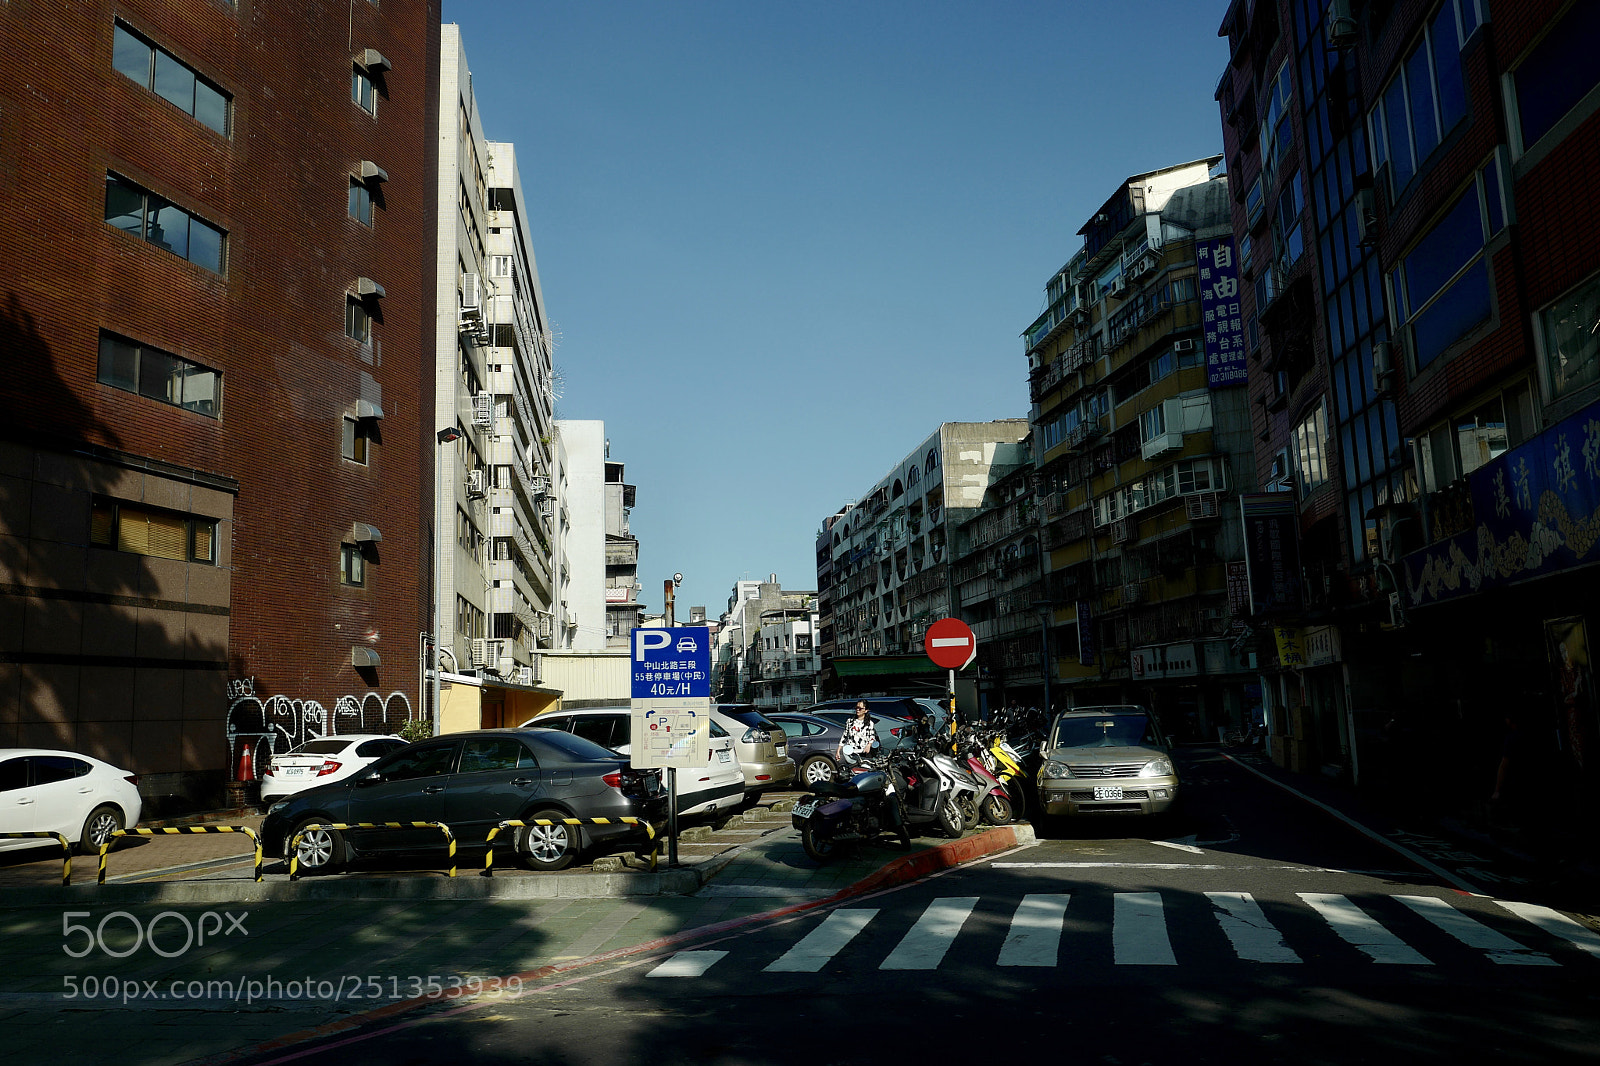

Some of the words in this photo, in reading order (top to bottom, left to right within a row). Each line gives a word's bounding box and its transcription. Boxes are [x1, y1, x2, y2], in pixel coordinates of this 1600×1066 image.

[1212, 243, 1238, 299] 自由
[1216, 304, 1230, 350] 電視台
[1229, 302, 1244, 348] 日報系
[635, 630, 672, 662] P
[635, 671, 706, 682] 55巷停車場(中民)
[643, 660, 697, 671] 中山北路三段
[650, 682, 691, 696] 40元/H
